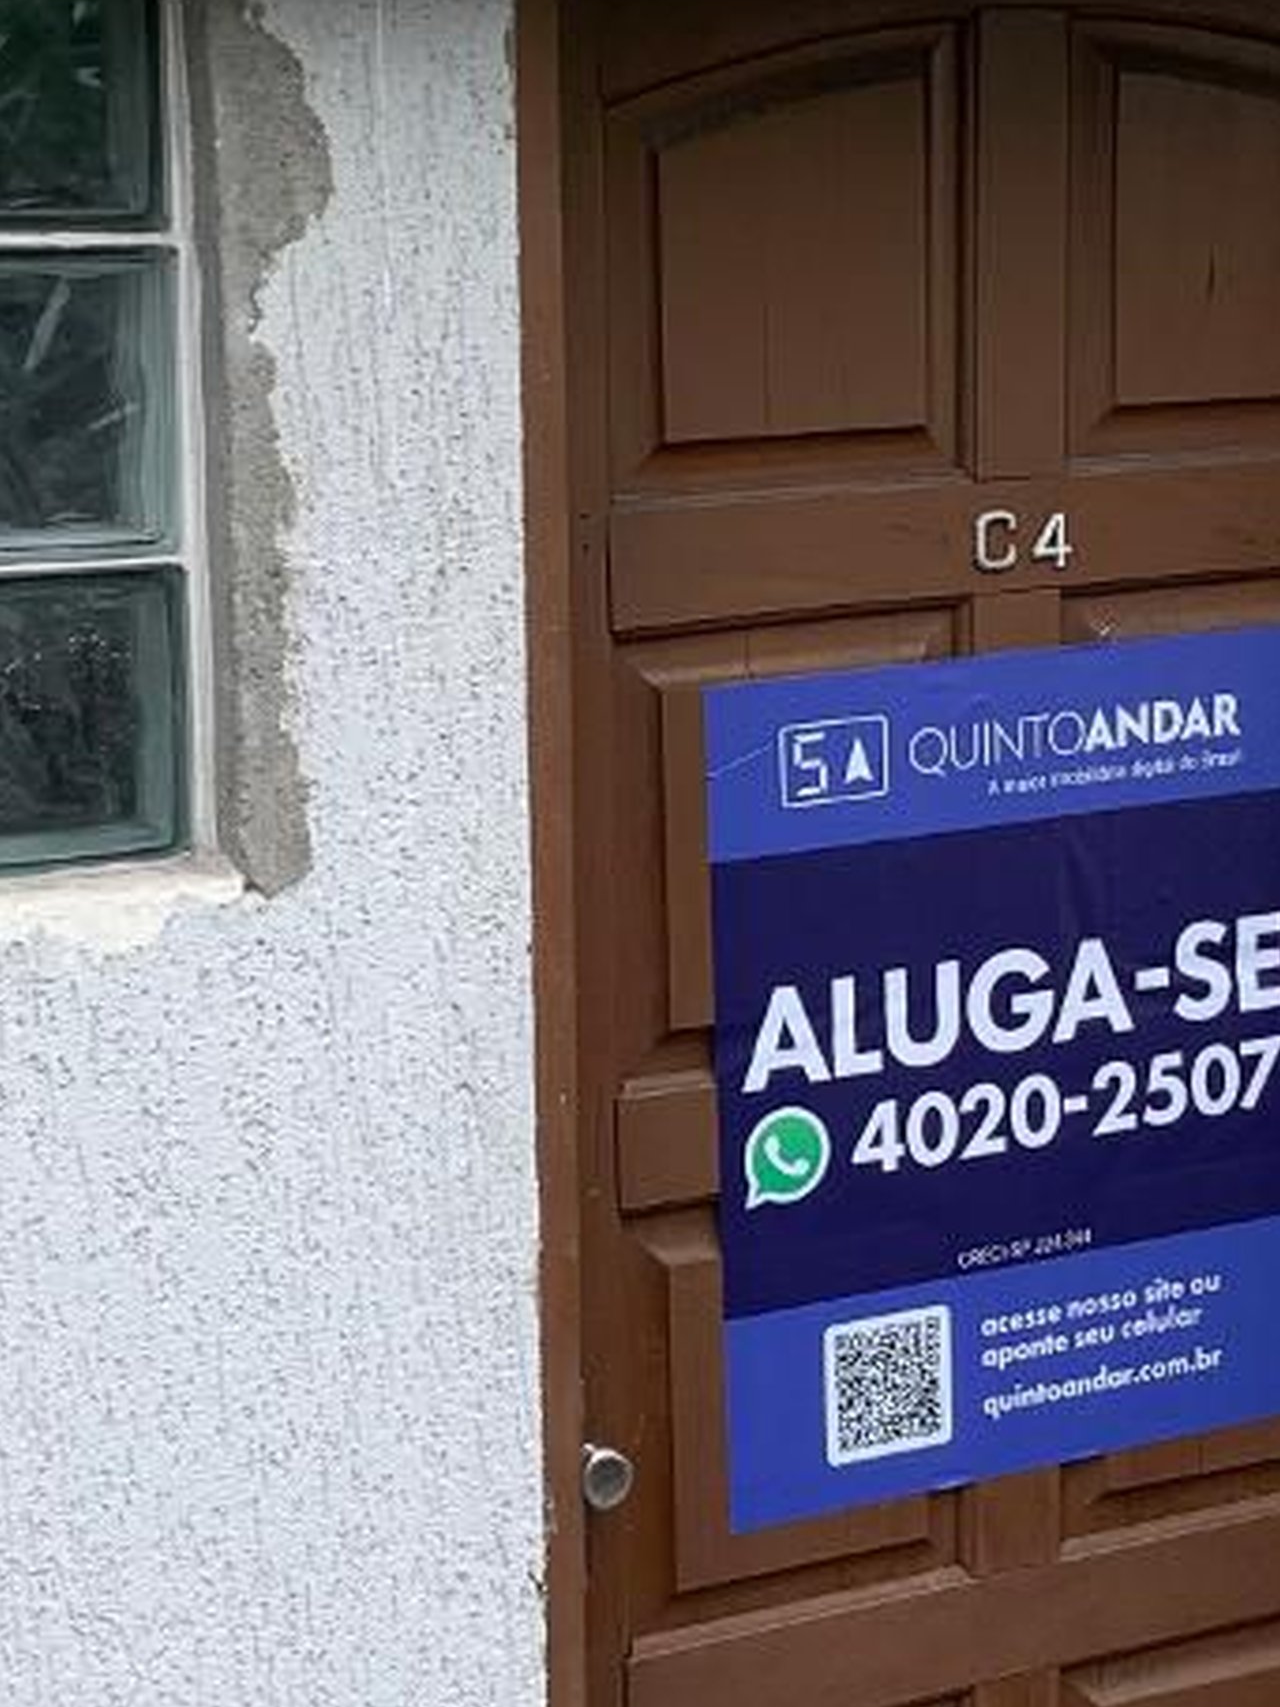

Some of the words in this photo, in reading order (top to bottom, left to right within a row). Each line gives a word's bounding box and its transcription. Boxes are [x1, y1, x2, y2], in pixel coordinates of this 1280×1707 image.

[908, 692, 1241, 776] QUINTOANDAR
[980, 1304, 1063, 1337] acesse
[1066, 1290, 1137, 1320] nosso
[1143, 1277, 1185, 1305] site
[1189, 1273, 1222, 1295] ou
[981, 1334, 1070, 1371] aponte
[1073, 1324, 1115, 1349] seu
[1120, 1304, 1204, 1340] celular
[982, 1345, 1223, 1421] quintoandar.com.br
